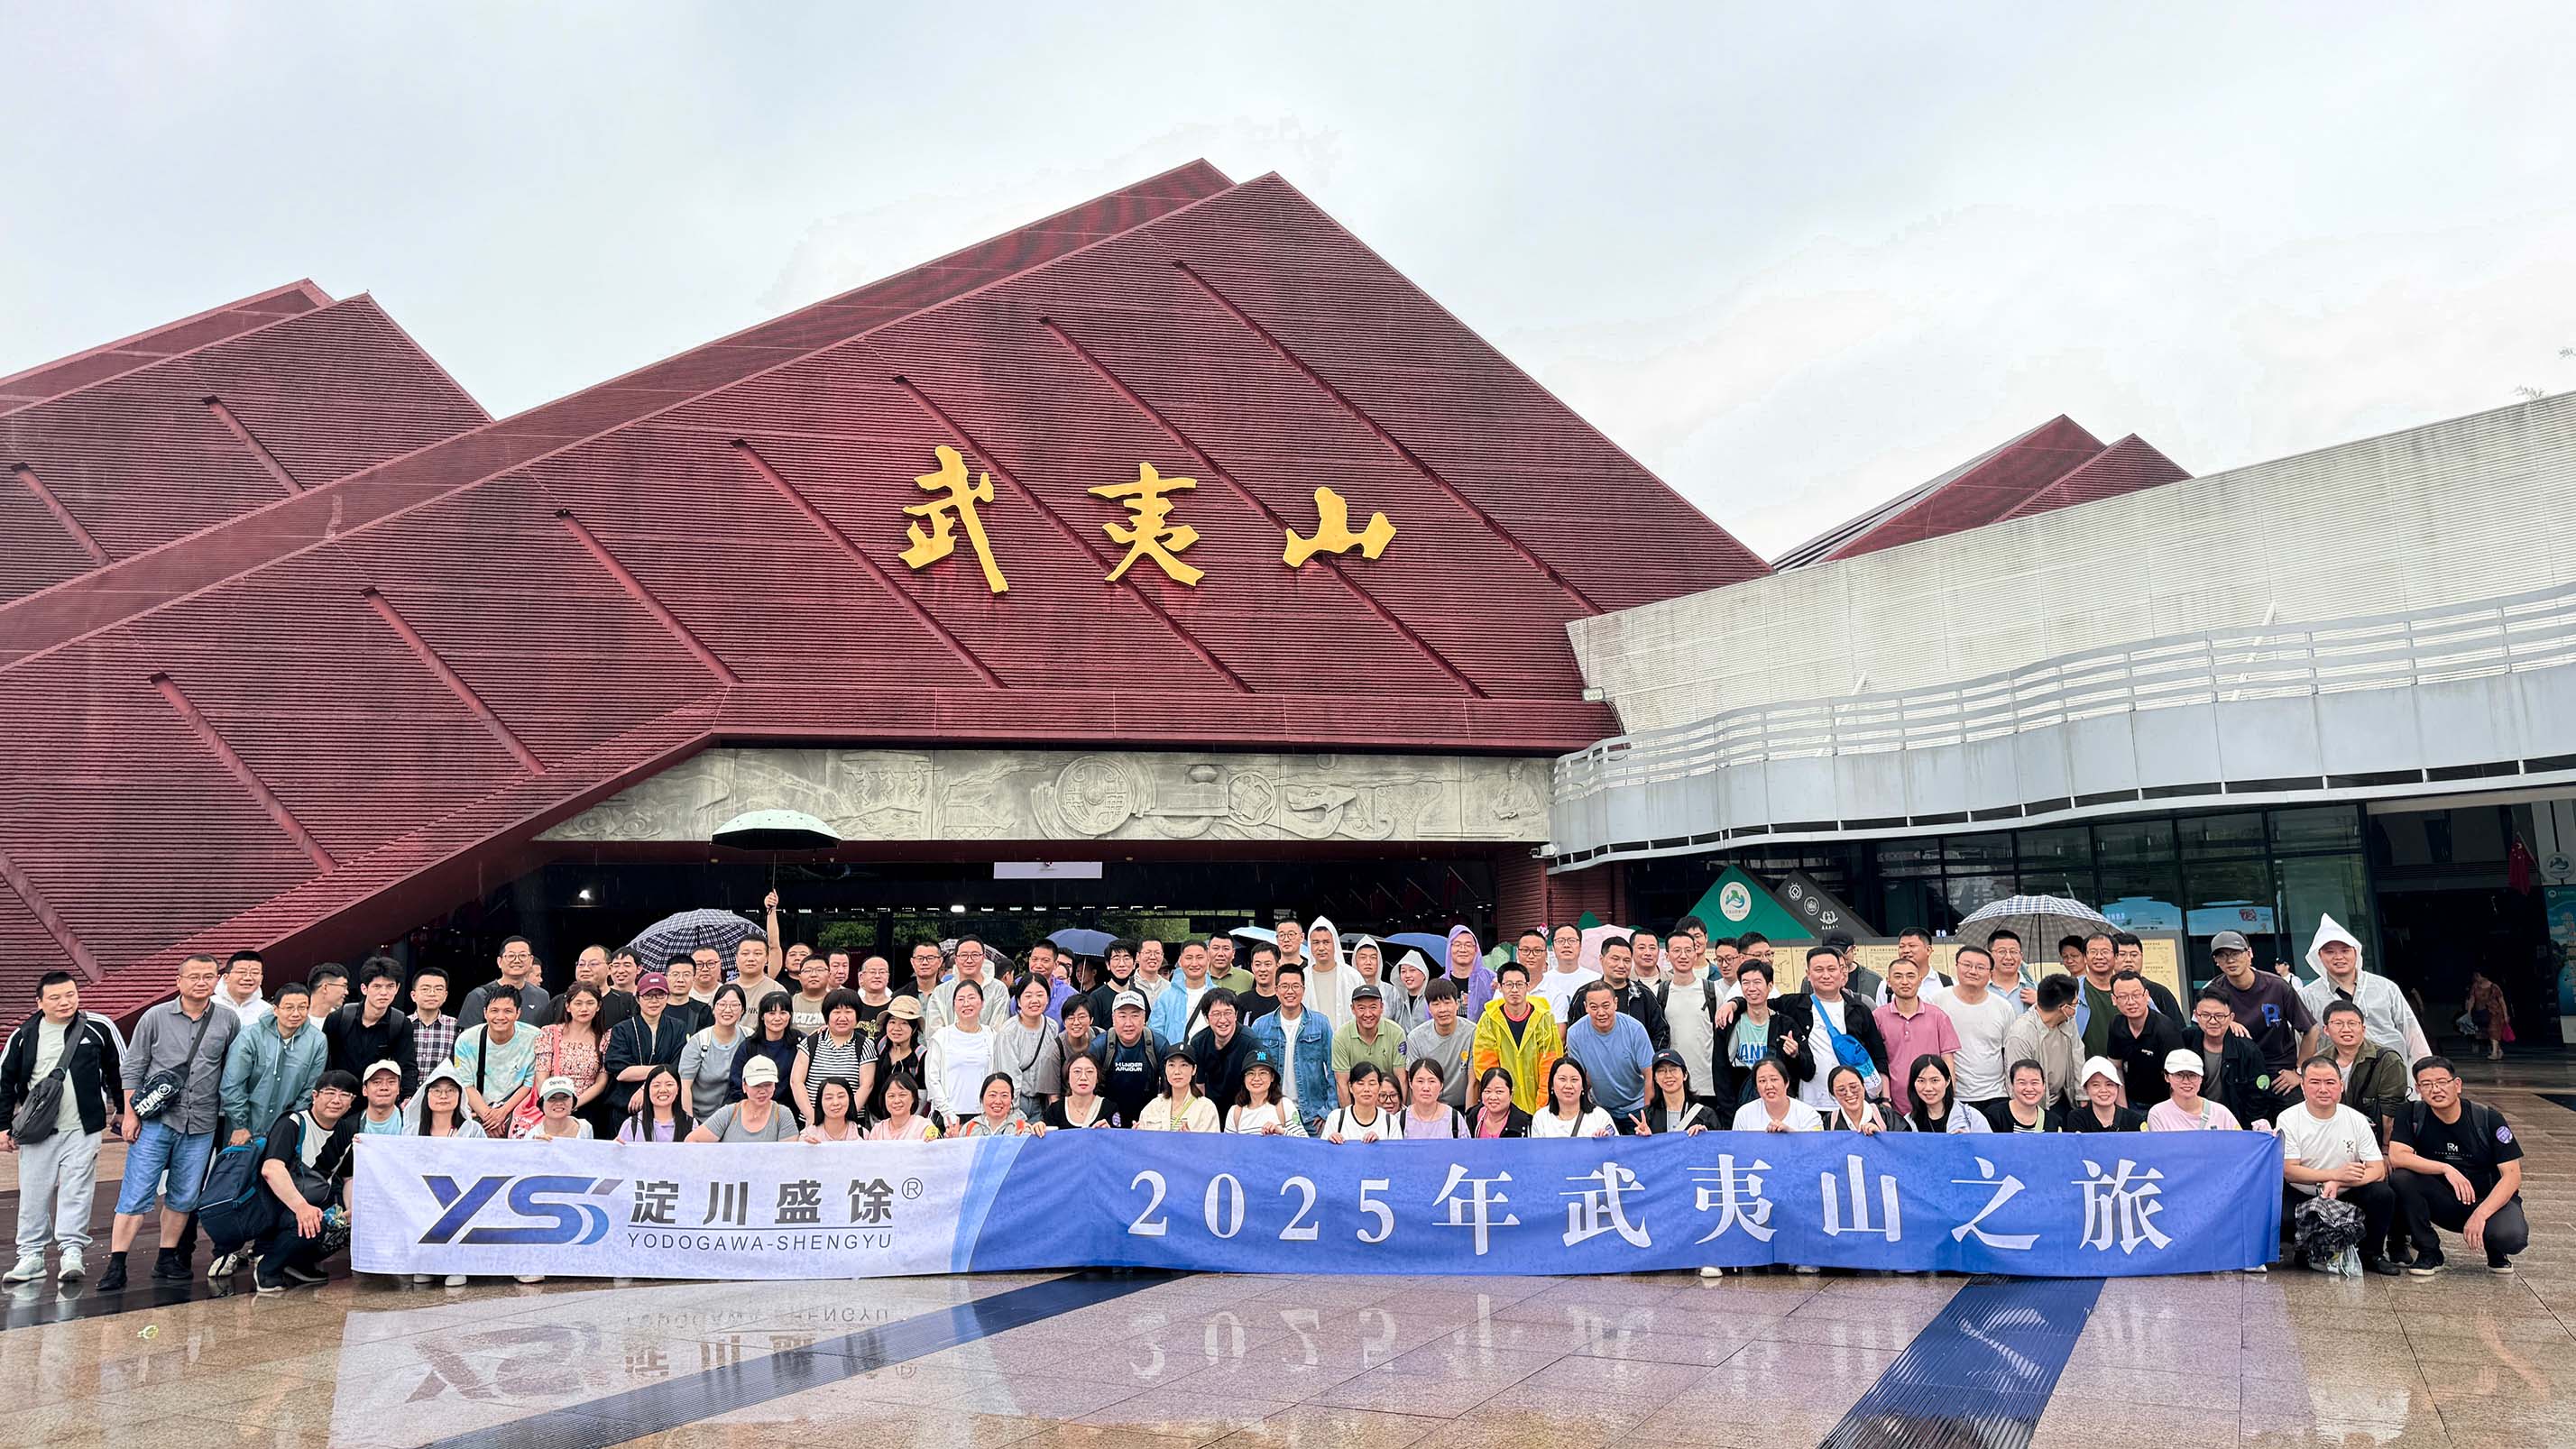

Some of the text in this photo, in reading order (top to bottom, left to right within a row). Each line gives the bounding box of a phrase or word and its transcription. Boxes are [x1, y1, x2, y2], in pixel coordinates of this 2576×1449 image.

[899, 445, 1396, 594] 武夷山
[134, 1089, 164, 1116] WADE
[627, 1233, 892, 1252] YODOGAWA-SHENGYU
